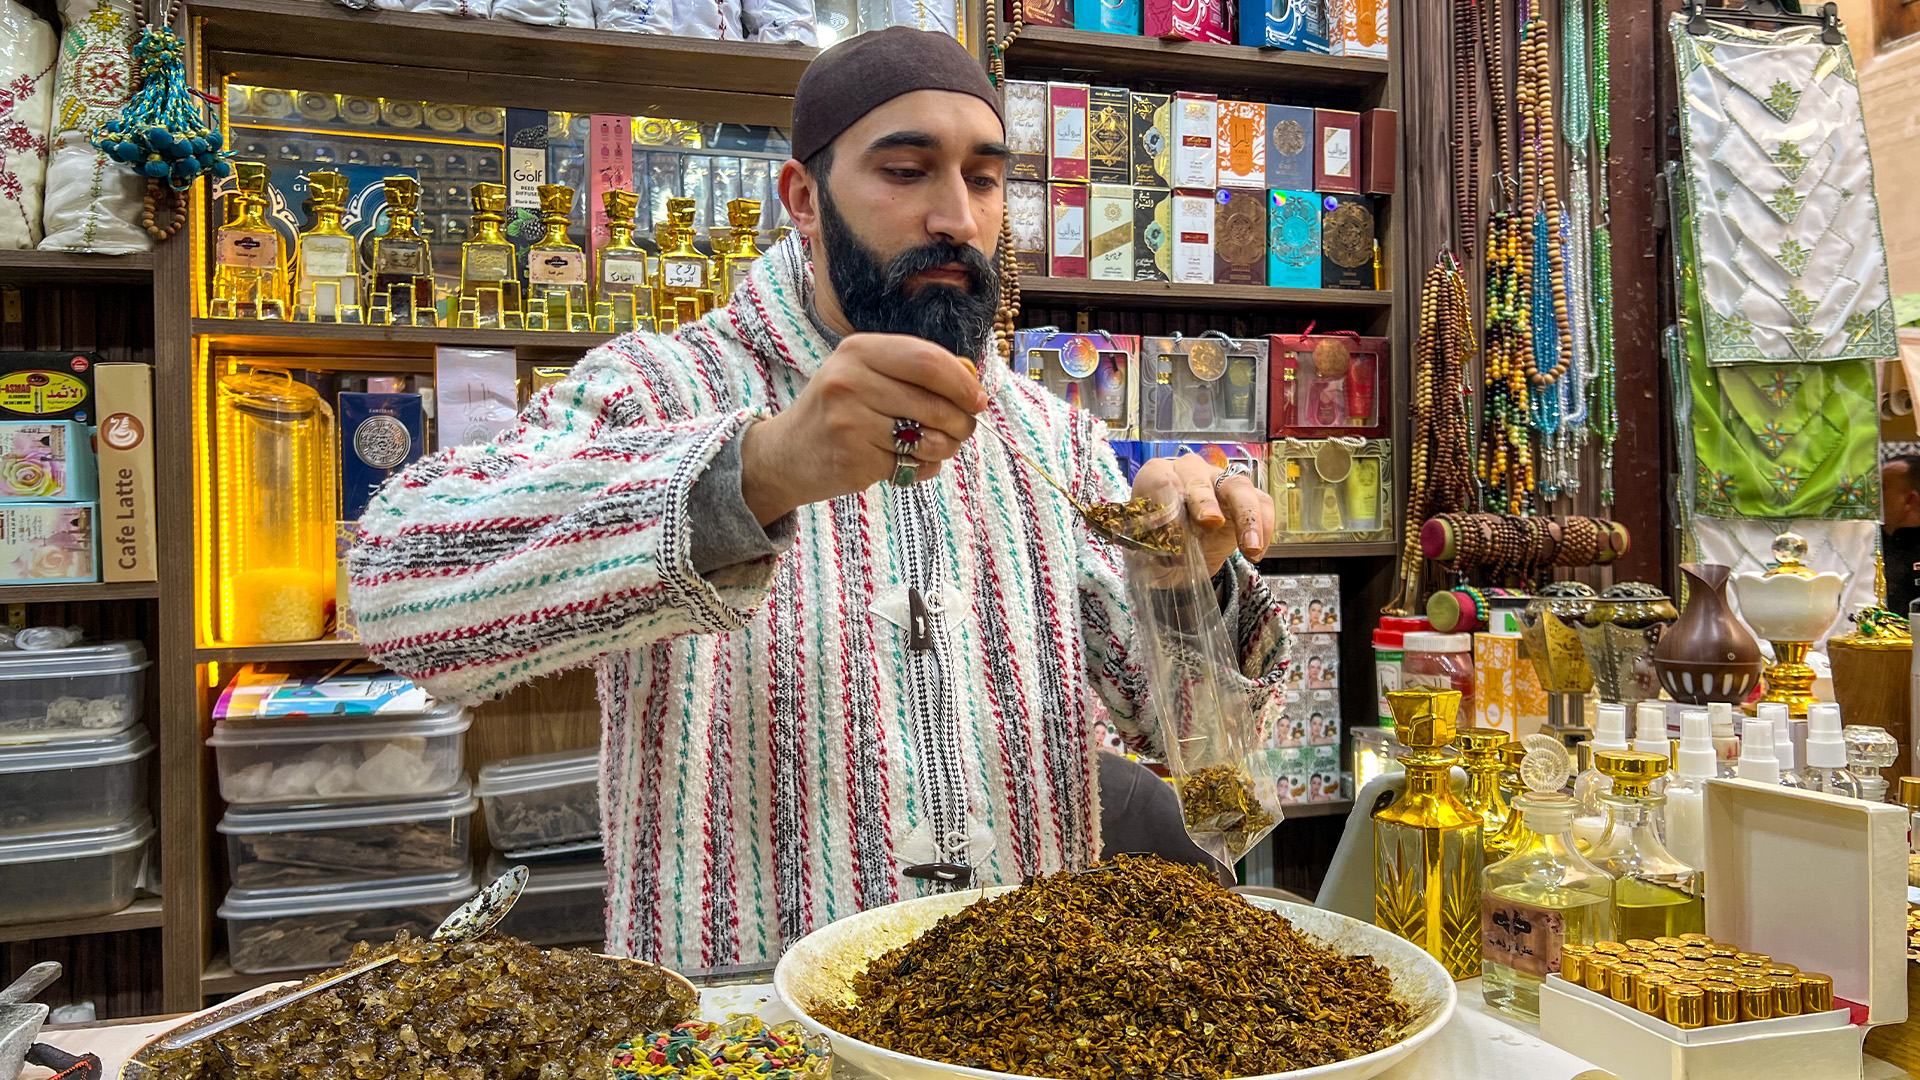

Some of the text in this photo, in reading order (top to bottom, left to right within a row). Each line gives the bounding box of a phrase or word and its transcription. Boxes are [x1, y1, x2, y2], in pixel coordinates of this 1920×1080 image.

[513, 169, 543, 183] Golf
[0, 384, 31, 394] -ASMAD
[115, 467, 136, 570] Cafe Latte
